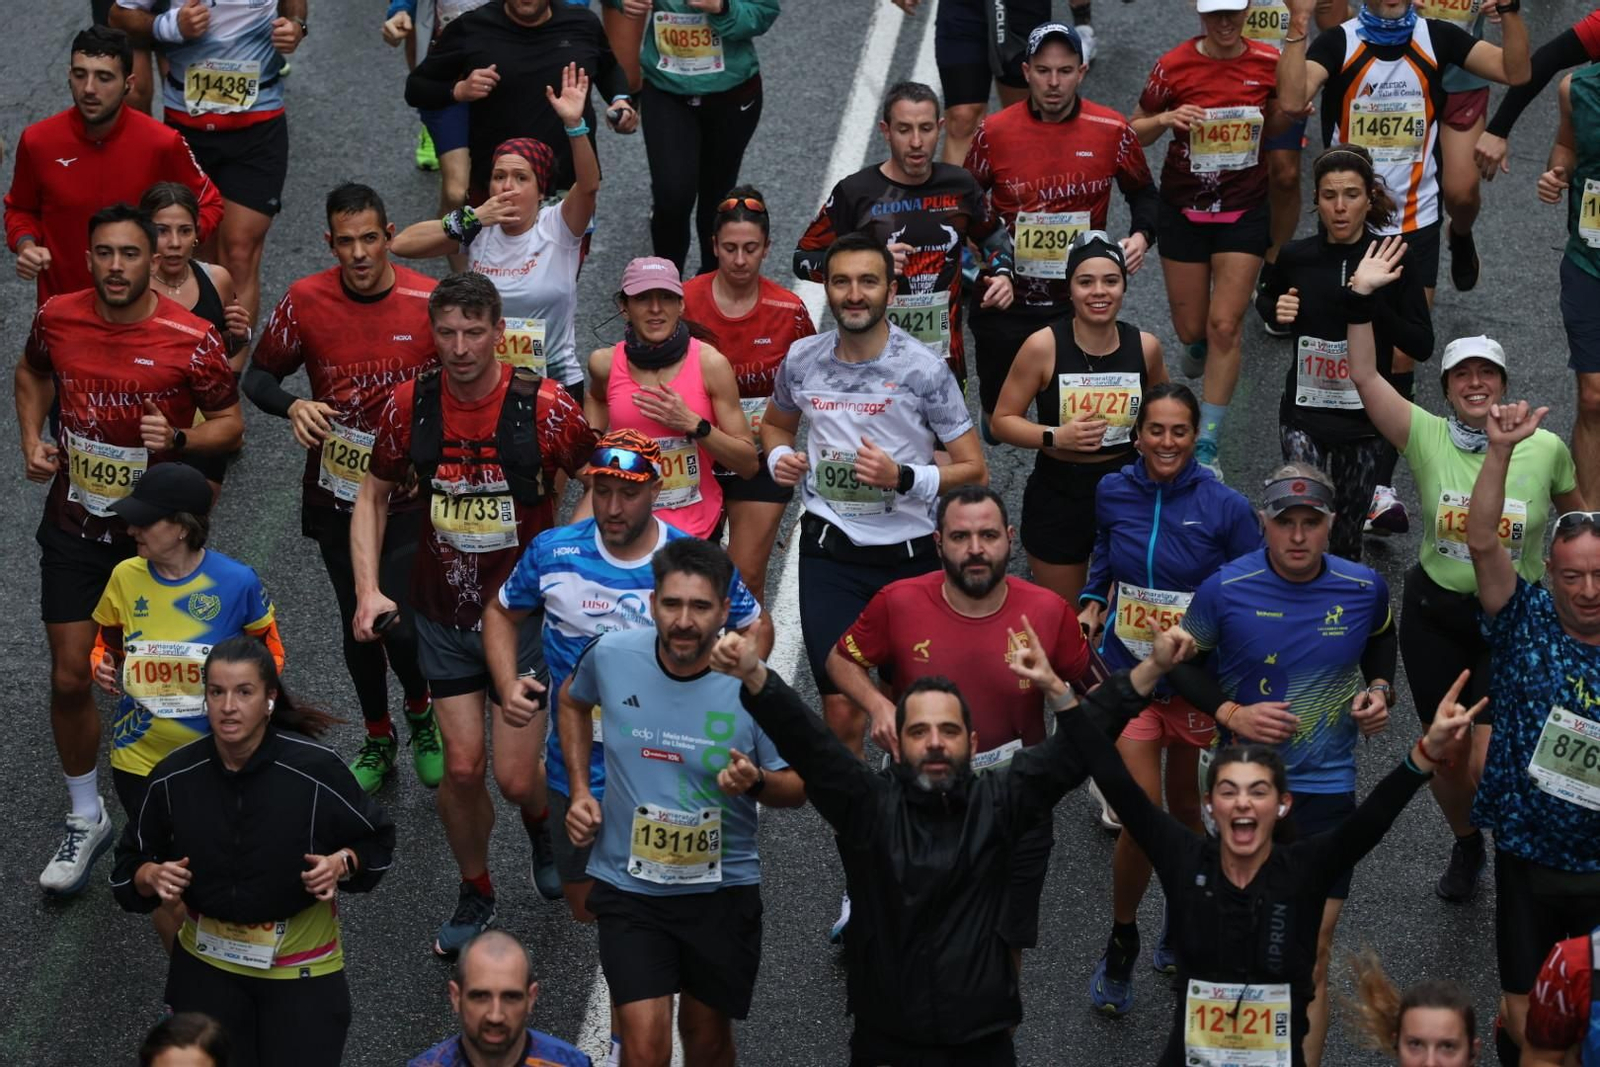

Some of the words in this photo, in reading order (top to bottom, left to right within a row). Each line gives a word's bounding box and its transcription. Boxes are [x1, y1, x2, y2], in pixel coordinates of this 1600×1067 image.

[661, 29, 711, 49] 10853
[192, 73, 247, 95] 11438
[1199, 122, 1251, 144] 14673
[1357, 117, 1414, 138] 14674
[1589, 197, 1600, 217] 1
[1021, 228, 1078, 250] 12394
[1304, 355, 1350, 380] 1786
[1068, 392, 1129, 415] 14727
[328, 440, 371, 474] 1280
[74, 454, 130, 487] 11493
[825, 466, 872, 490] 929
[441, 497, 500, 521] 11733
[1444, 511, 1511, 538] 133
[552, 546, 580, 558] HOKA
[582, 599, 609, 610] LUSO
[131, 661, 200, 684] 10915
[632, 728, 653, 742] edp
[1553, 733, 1600, 769] 876
[641, 824, 709, 853] 13118
